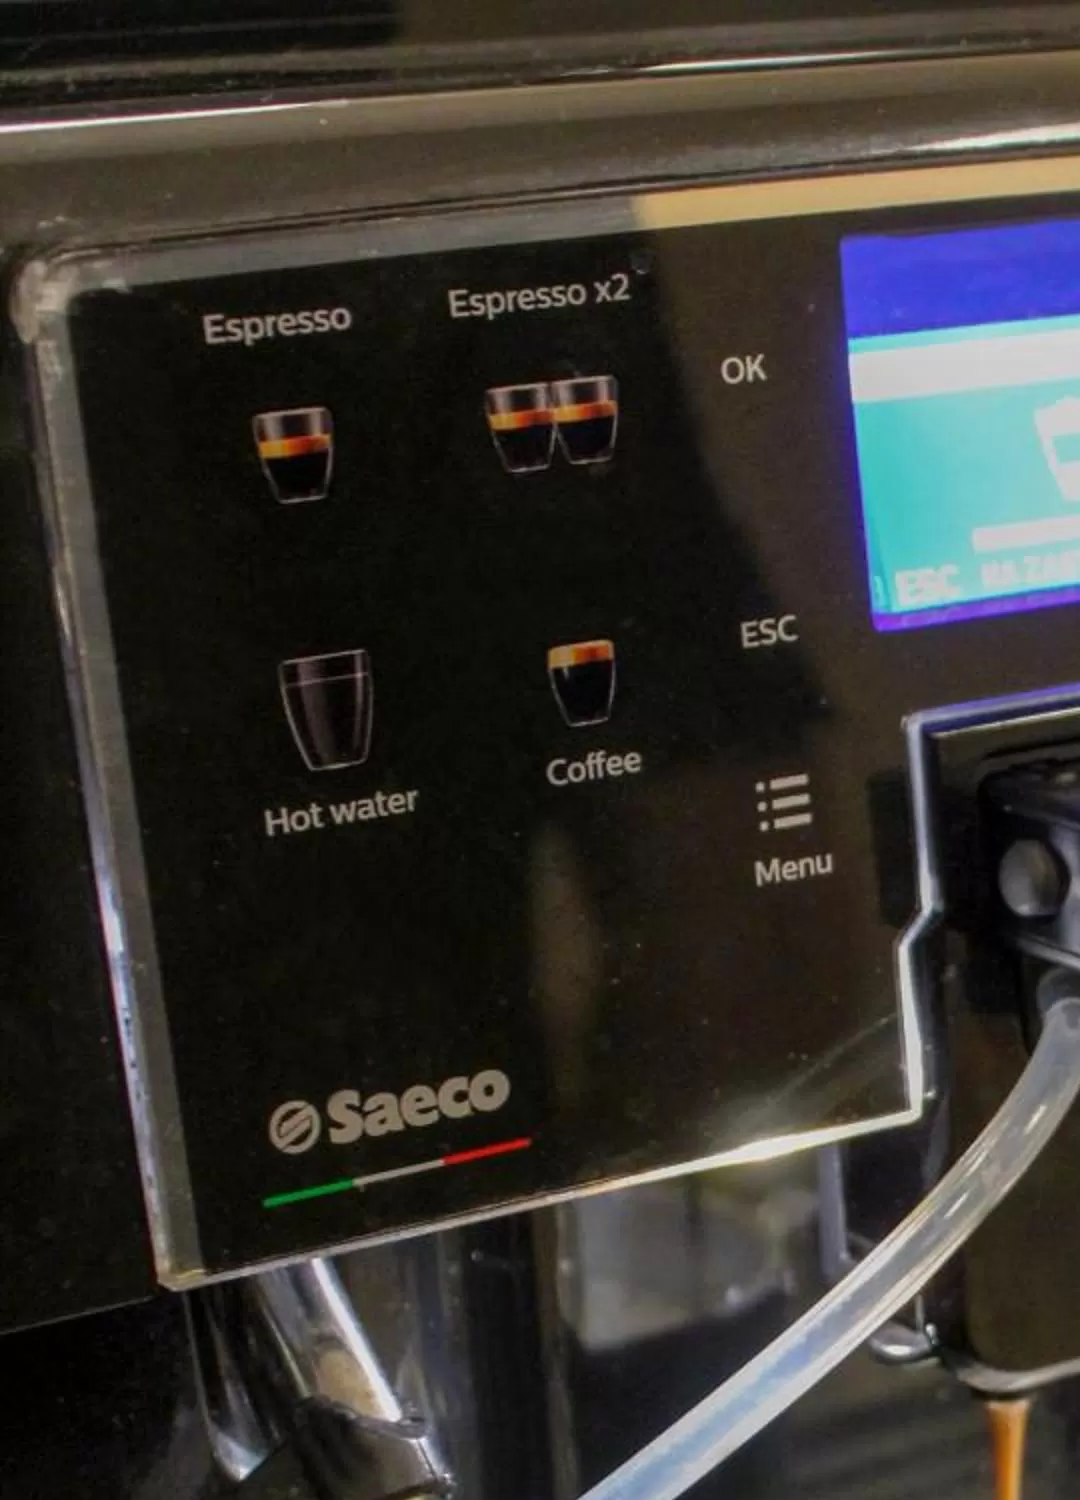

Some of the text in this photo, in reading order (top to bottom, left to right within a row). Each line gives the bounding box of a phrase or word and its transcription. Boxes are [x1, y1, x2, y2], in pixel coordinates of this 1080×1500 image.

[448, 272, 631, 321] Espresso x2
[203, 307, 353, 347] Espresso
[720, 353, 767, 385] OK
[740, 614, 799, 649] ESC
[546, 750, 642, 786] Coffee
[265, 788, 419, 837] Hot water
[755, 853, 833, 887] Menu
[327, 1070, 511, 1144] Saeco
